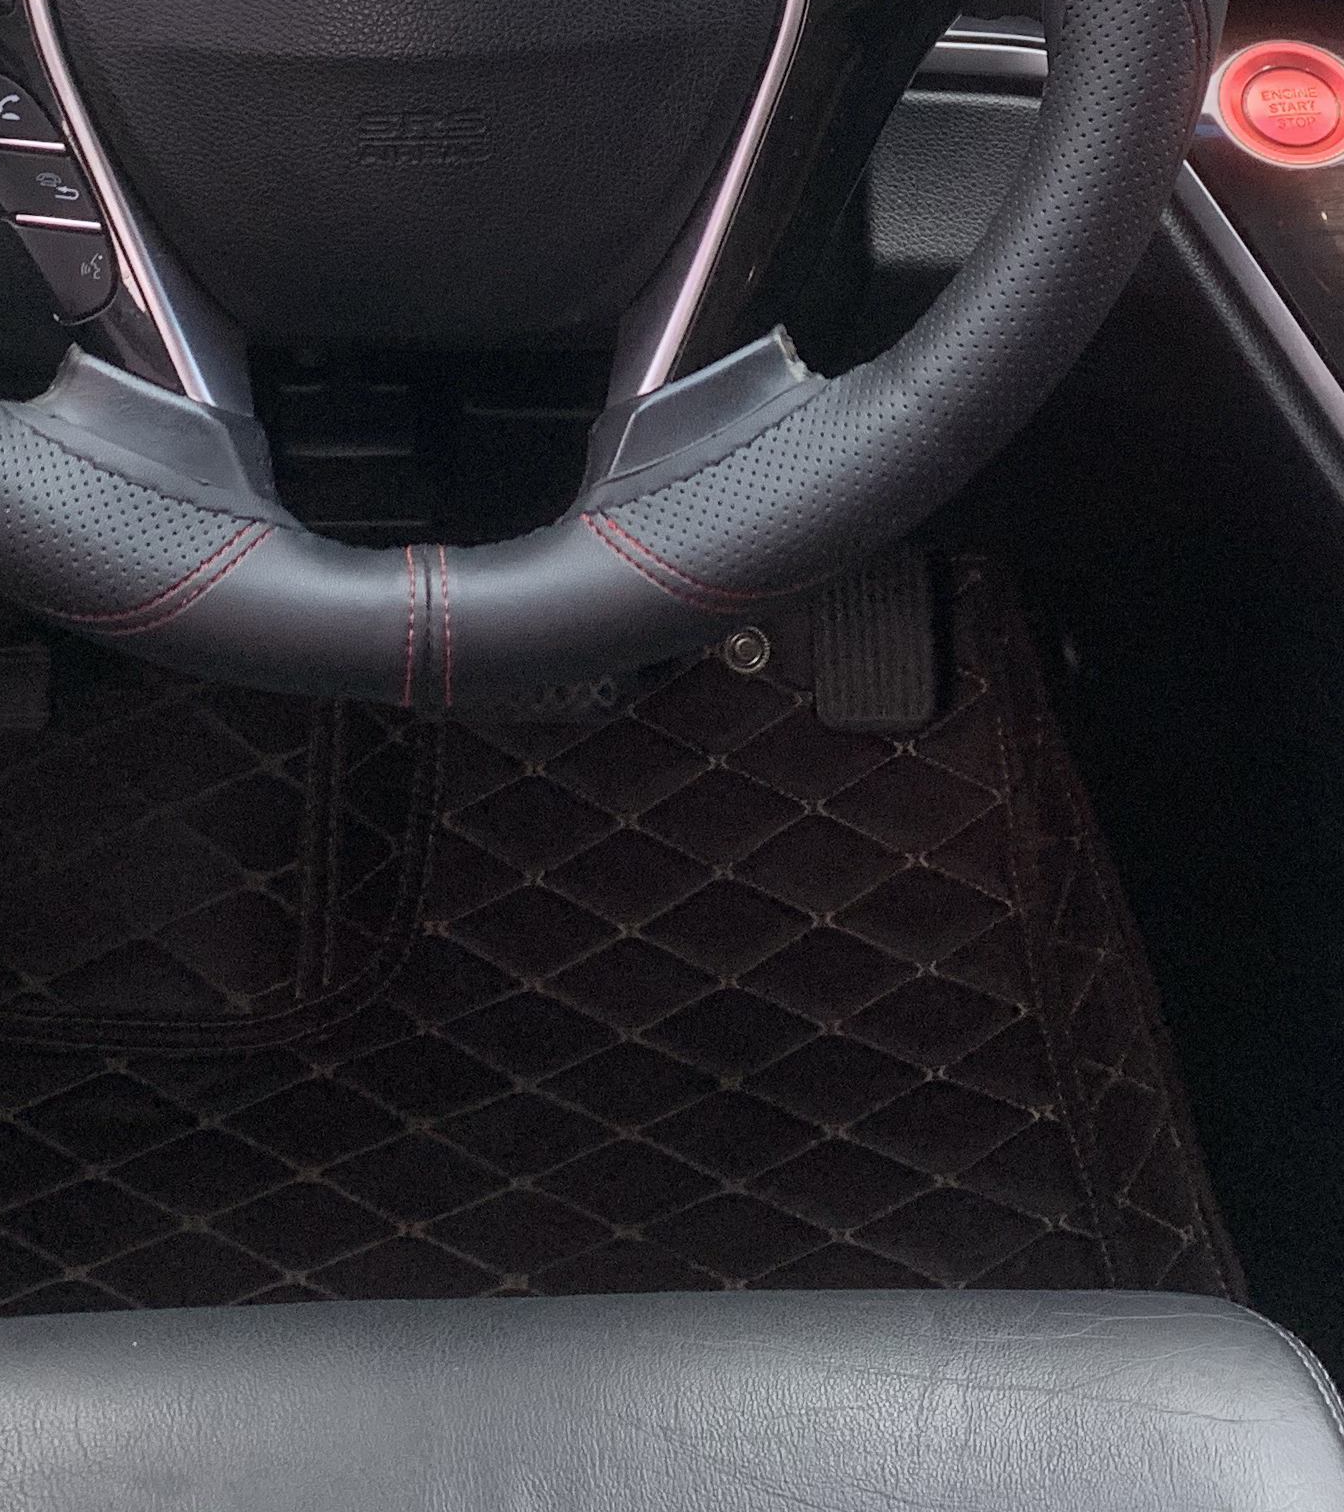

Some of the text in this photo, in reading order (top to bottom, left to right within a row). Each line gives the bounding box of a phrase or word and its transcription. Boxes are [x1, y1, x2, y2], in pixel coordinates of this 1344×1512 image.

[1260, 87, 1319, 101] ENGINE
[1268, 100, 1316, 114] START
[1276, 116, 1317, 130] STOP
